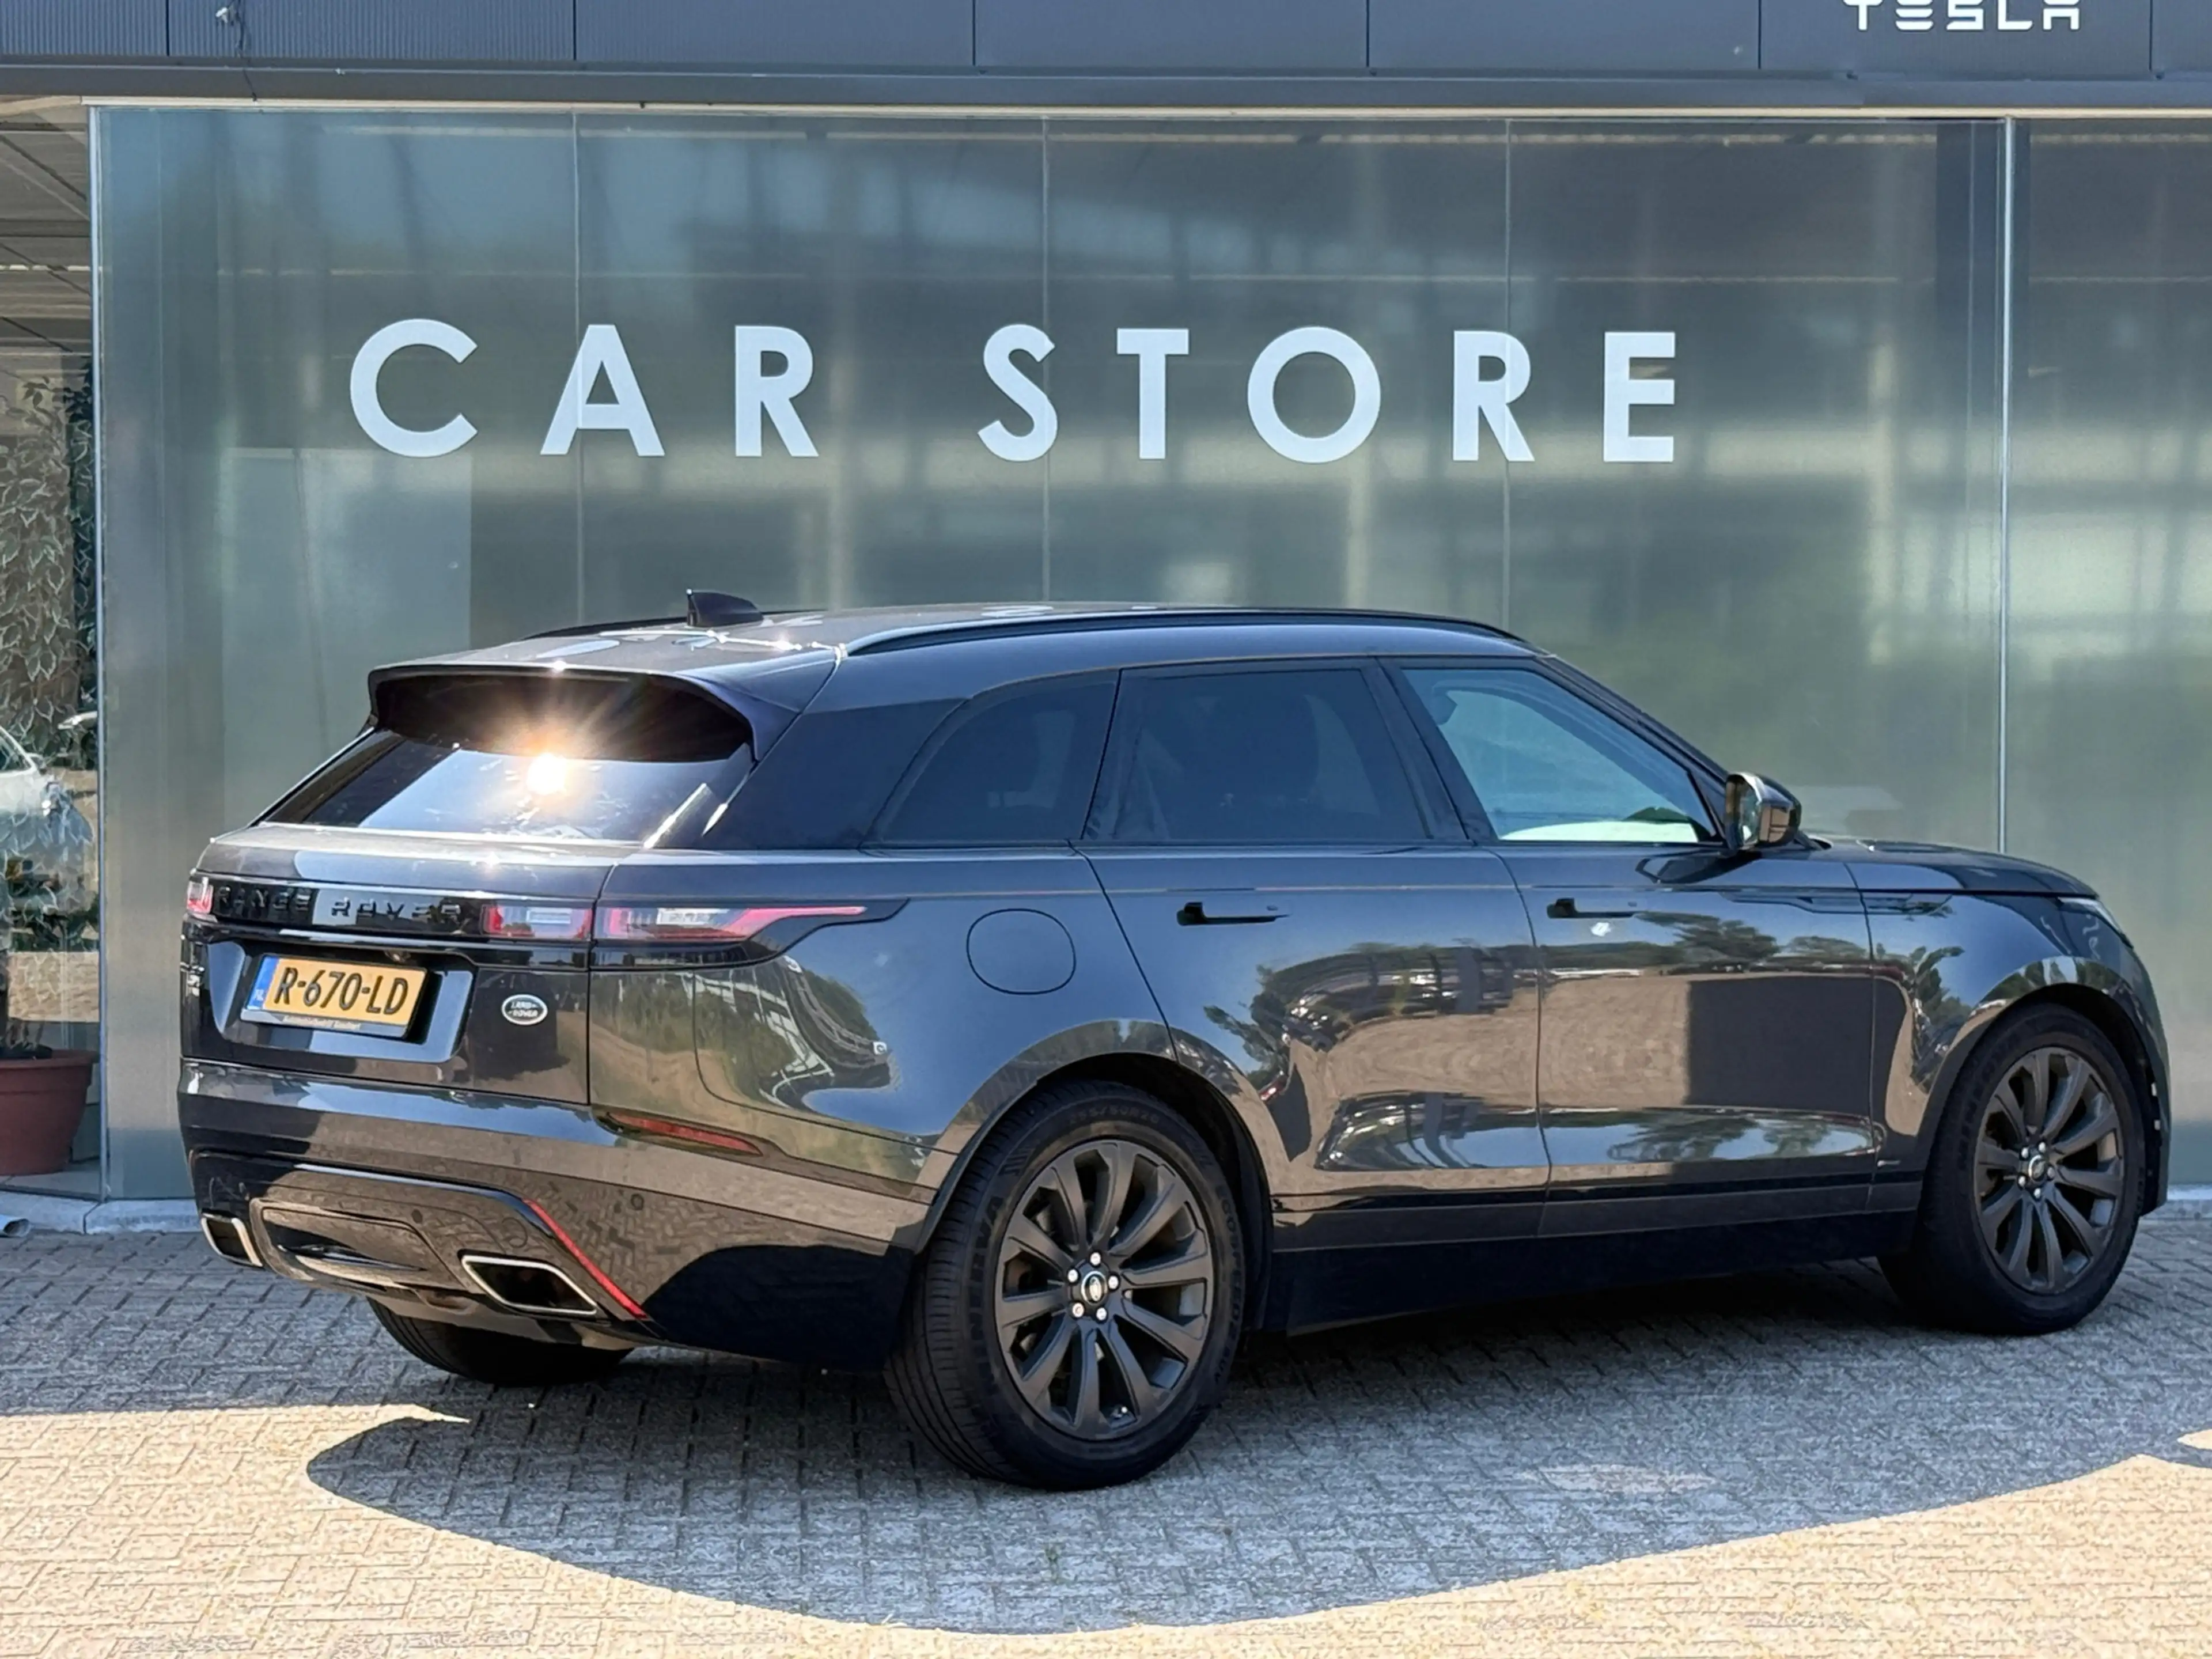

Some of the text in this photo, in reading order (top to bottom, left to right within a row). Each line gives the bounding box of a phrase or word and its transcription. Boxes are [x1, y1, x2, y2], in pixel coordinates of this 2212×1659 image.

[1843, 0, 2081, 31] TESLA
[349, 318, 1677, 464] CAR STORE
[274, 967, 408, 1015] R-670-LD
